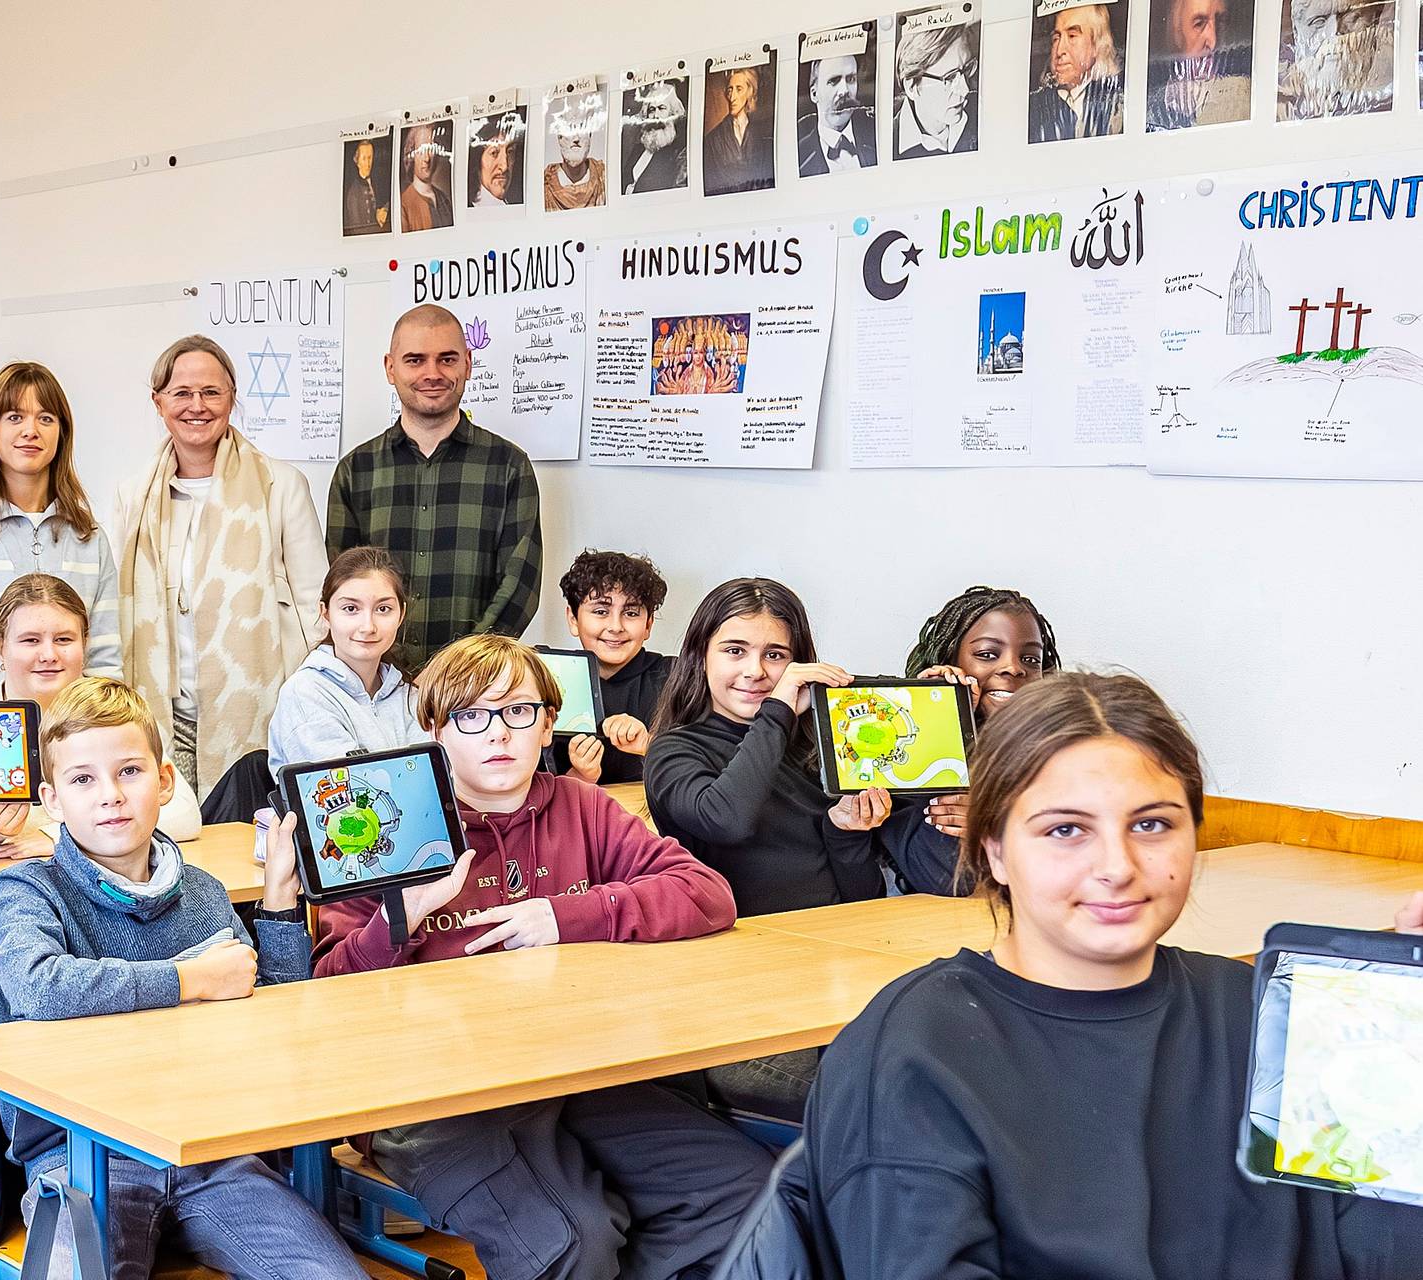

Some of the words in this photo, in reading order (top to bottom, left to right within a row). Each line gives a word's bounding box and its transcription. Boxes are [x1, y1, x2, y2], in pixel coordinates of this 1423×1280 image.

[939, 206, 1062, 259] Islam
[415, 240, 575, 303] BUDDHISMUS
[622, 237, 802, 280] HINDUISMUS
[209, 278, 331, 325] JUDENTUM
[1165, 282, 1193, 295] Kirche
